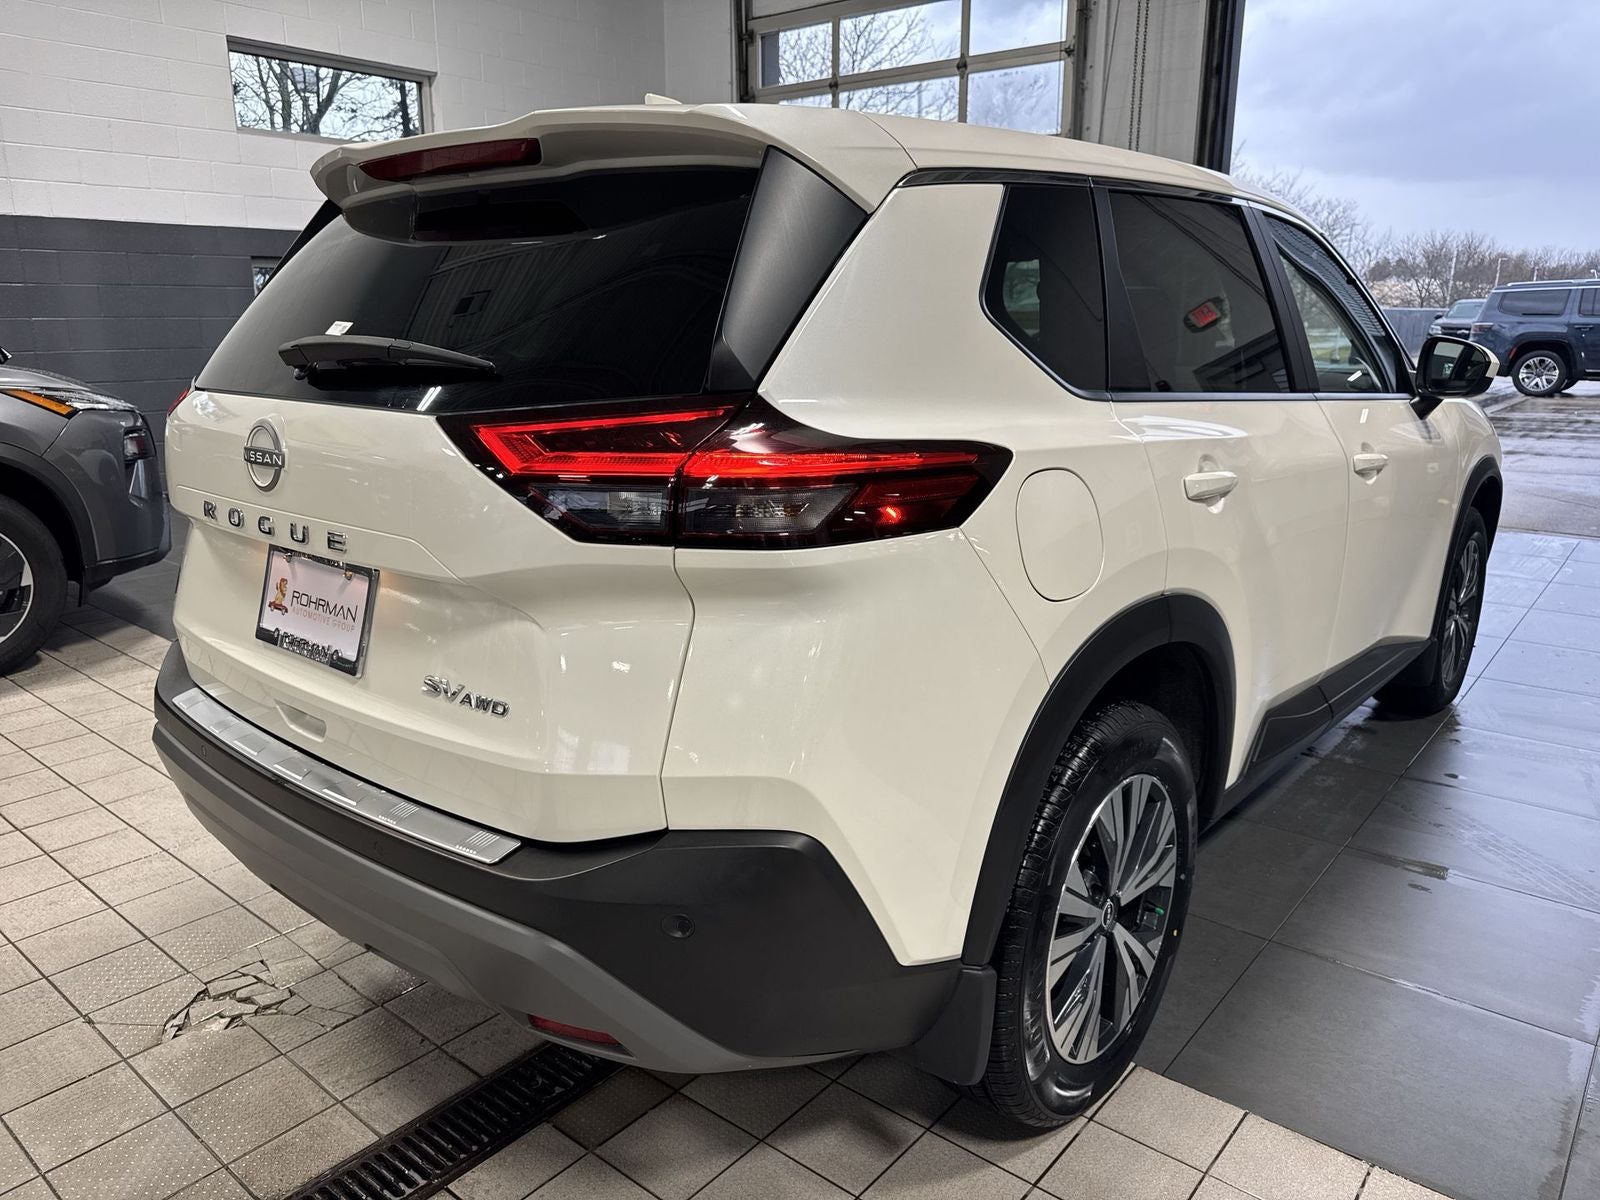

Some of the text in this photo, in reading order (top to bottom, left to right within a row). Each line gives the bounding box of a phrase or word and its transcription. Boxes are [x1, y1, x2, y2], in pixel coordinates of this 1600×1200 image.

[203, 500, 348, 554] ROGUE
[290, 590, 358, 622] ROHRMAN
[292, 606, 331, 626] AUTOMOTIVE
[421, 675, 510, 718] SV AWD
